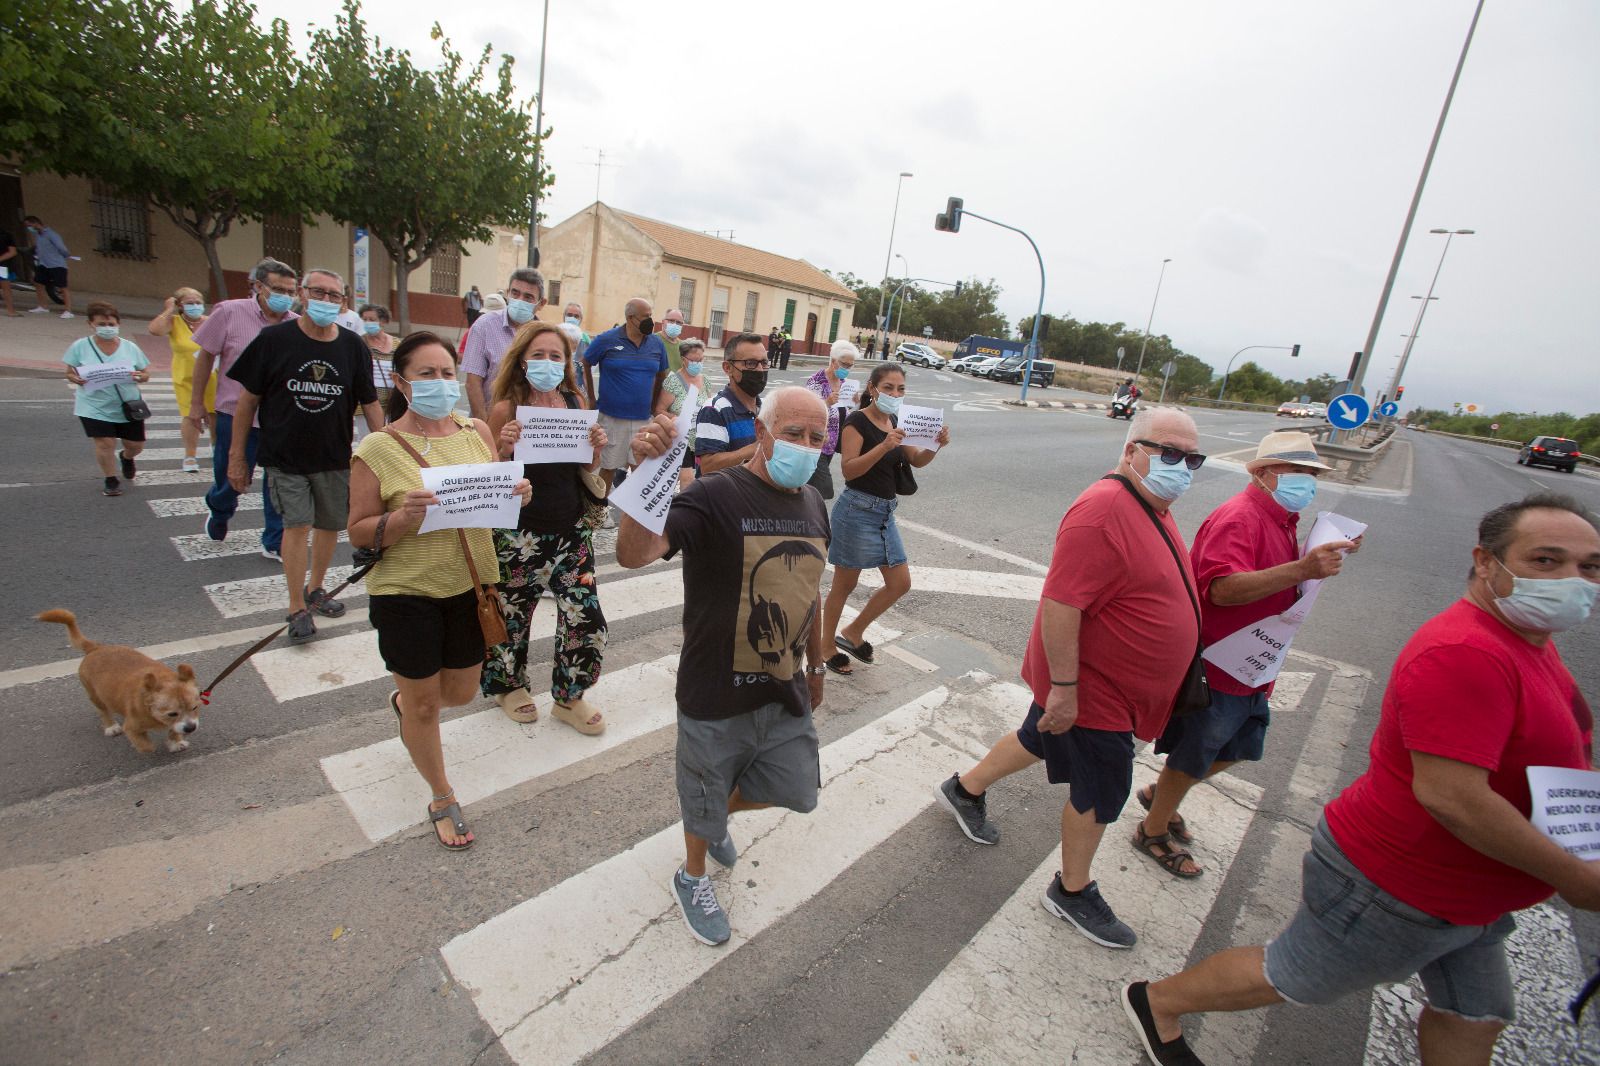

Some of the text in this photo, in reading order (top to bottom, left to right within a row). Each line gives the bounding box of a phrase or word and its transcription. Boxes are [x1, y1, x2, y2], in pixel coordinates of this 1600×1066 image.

[287, 379, 342, 395] GUINNESS
[640, 440, 687, 500] ¡QUEREMOS
[441, 475, 491, 487] ¡QUEREMOS
[435, 485, 475, 496] MERCADO
[468, 493, 481, 502] DEL
[741, 517, 774, 532] MUSIC
[1545, 804, 1581, 816] MERCADO
[1547, 823, 1578, 836] VUELTA
[1578, 822, 1593, 833] DEL
